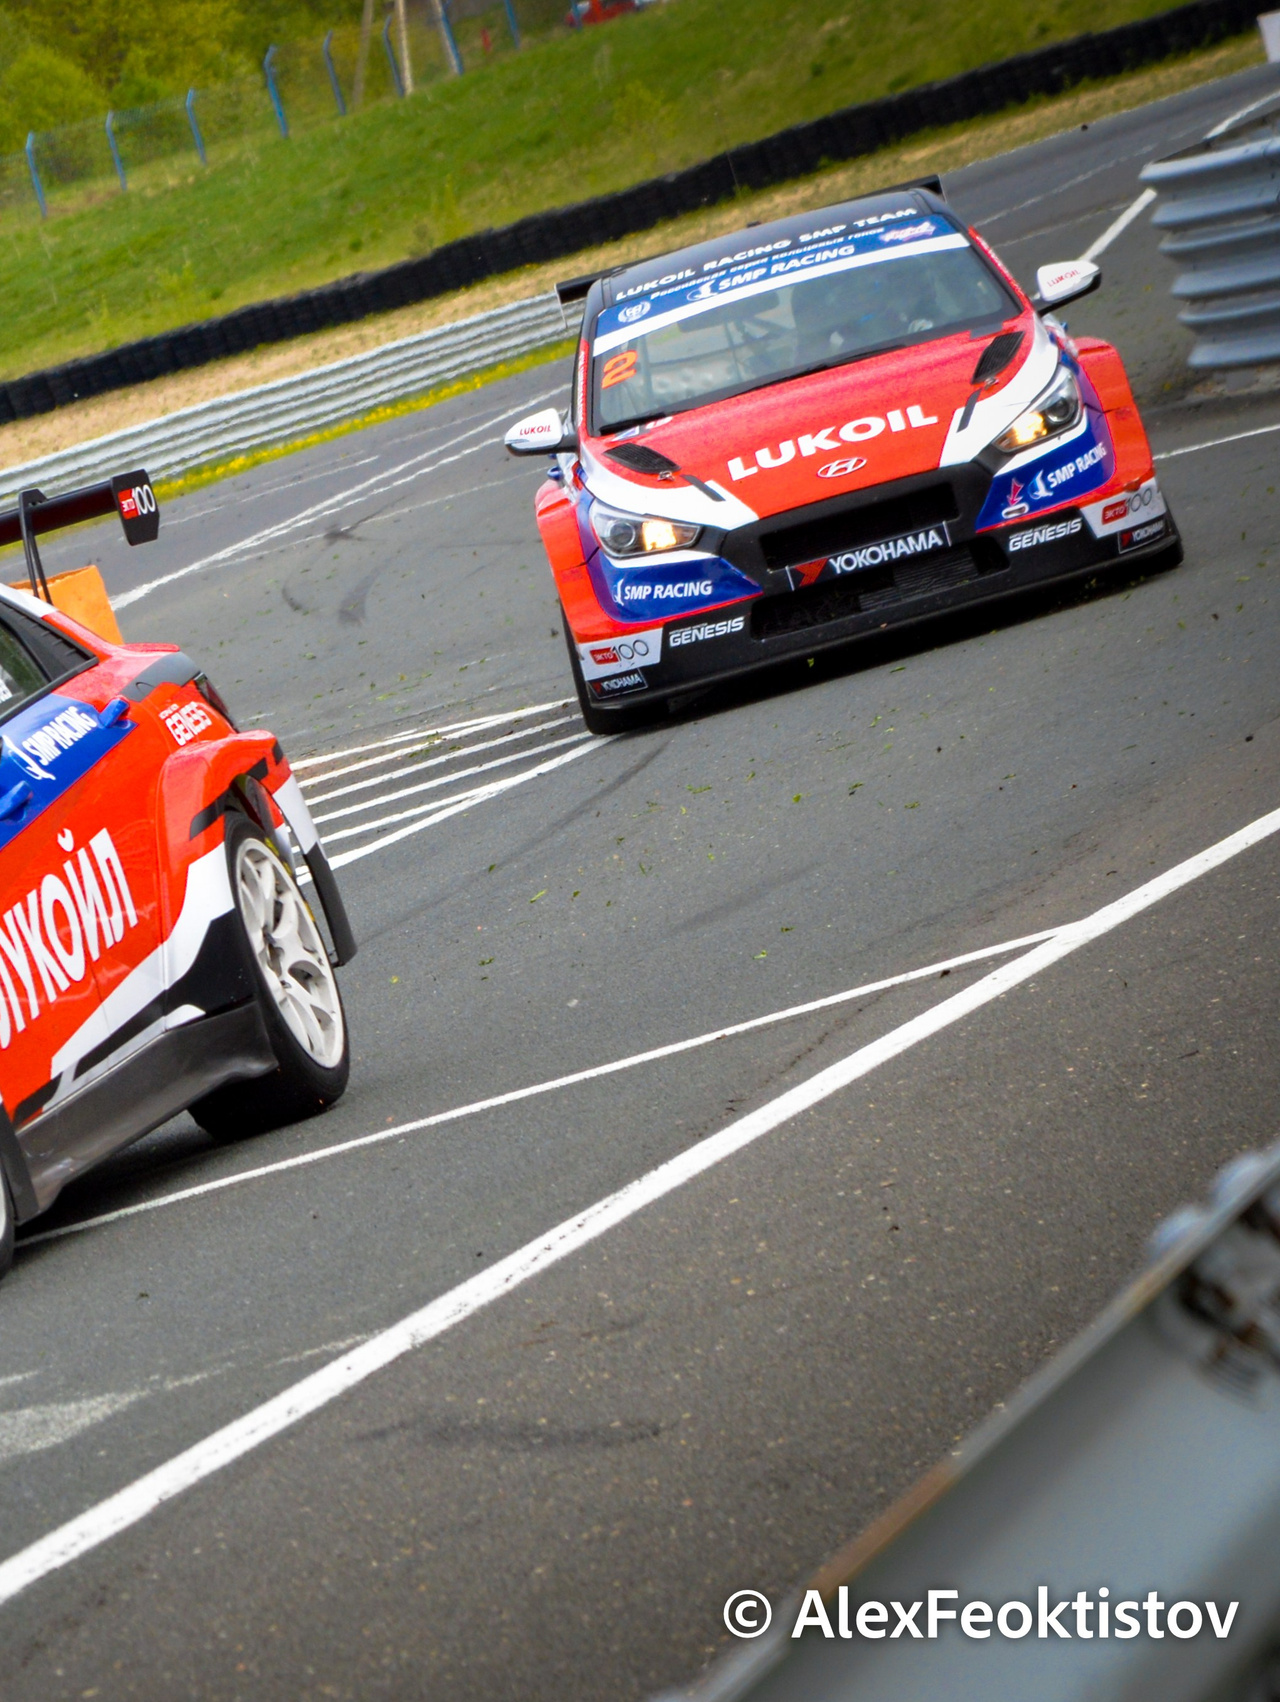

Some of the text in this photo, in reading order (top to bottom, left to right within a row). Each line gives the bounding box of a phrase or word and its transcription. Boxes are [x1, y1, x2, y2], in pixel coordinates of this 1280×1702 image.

[616, 208, 918, 301] LUKOIL RACING SMP TEAM
[718, 244, 856, 291] SMP RACING
[601, 350, 638, 389] 2
[520, 425, 552, 436] LUKOIL
[727, 405, 939, 482] LUKOIL
[1047, 442, 1108, 489] SMP RACING
[131, 484, 157, 516] 100
[1125, 488, 1153, 515] 100
[829, 529, 943, 575] YOKOHAMA
[1008, 517, 1083, 552] GENESIS
[623, 580, 714, 601] SMP RACING
[669, 615, 745, 648] GENESIS
[612, 638, 650, 663] 100
[21, 705, 98, 766] SMP RACING
